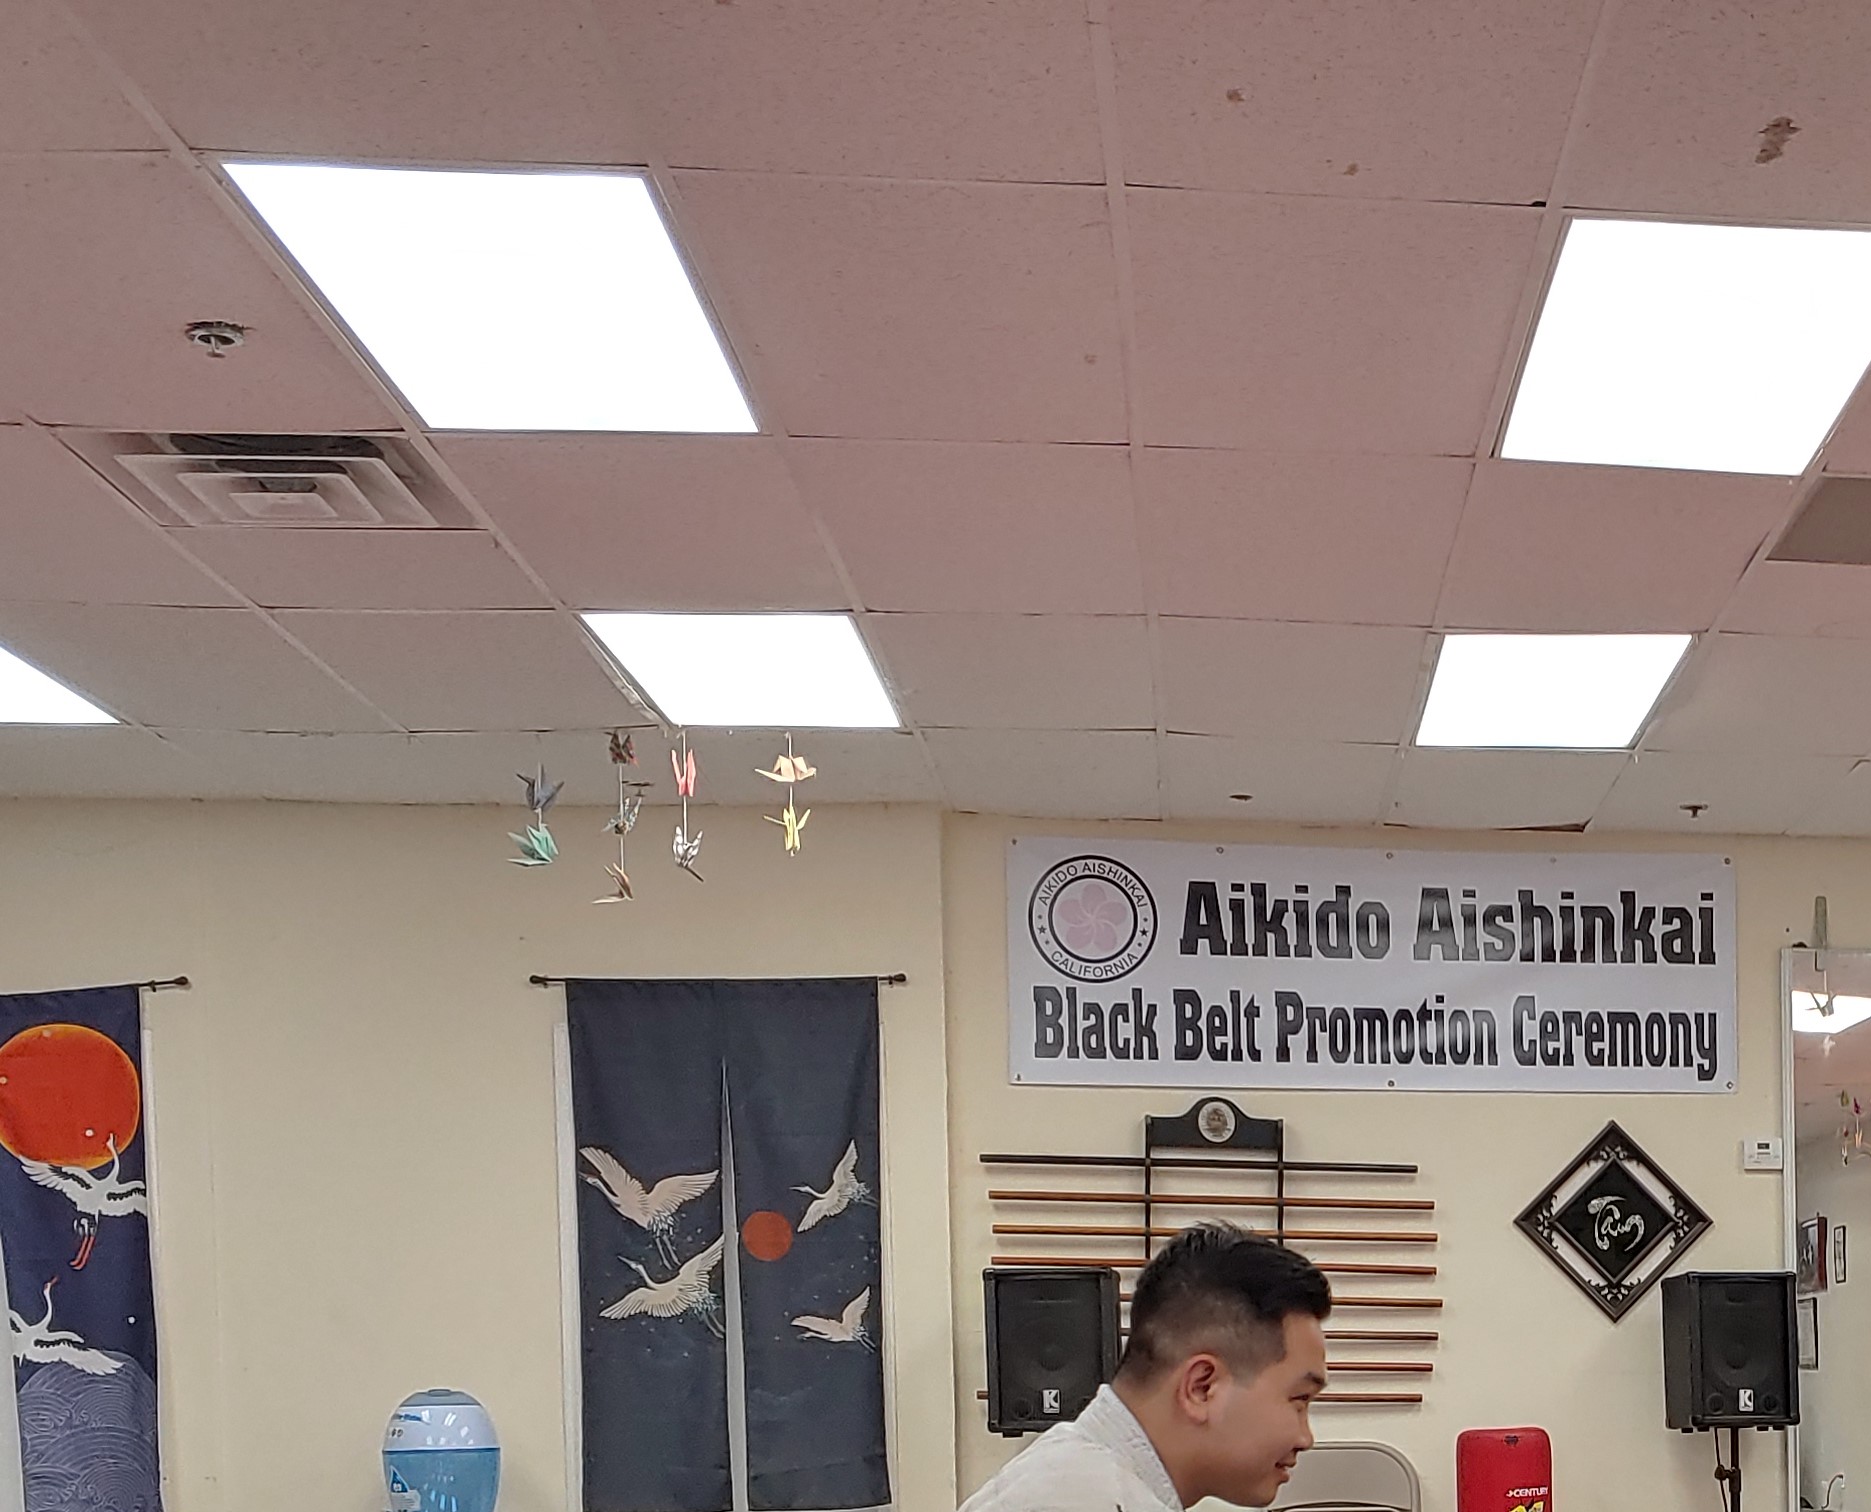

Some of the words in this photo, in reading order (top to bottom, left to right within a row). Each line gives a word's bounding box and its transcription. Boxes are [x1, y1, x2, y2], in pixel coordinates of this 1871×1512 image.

[1038, 864, 1078, 907] AIKIDO
[1082, 861, 1148, 908] AISHINKAI
[1179, 881, 1391, 960] Aikido
[1413, 887, 1716, 965] Aishinkai
[1051, 951, 1139, 978] CALIFORNIA
[1033, 985, 1159, 1060] Black
[1173, 988, 1262, 1062] Belt
[1274, 990, 1498, 1066] Promotion
[1512, 995, 1718, 1082] Ceremony
